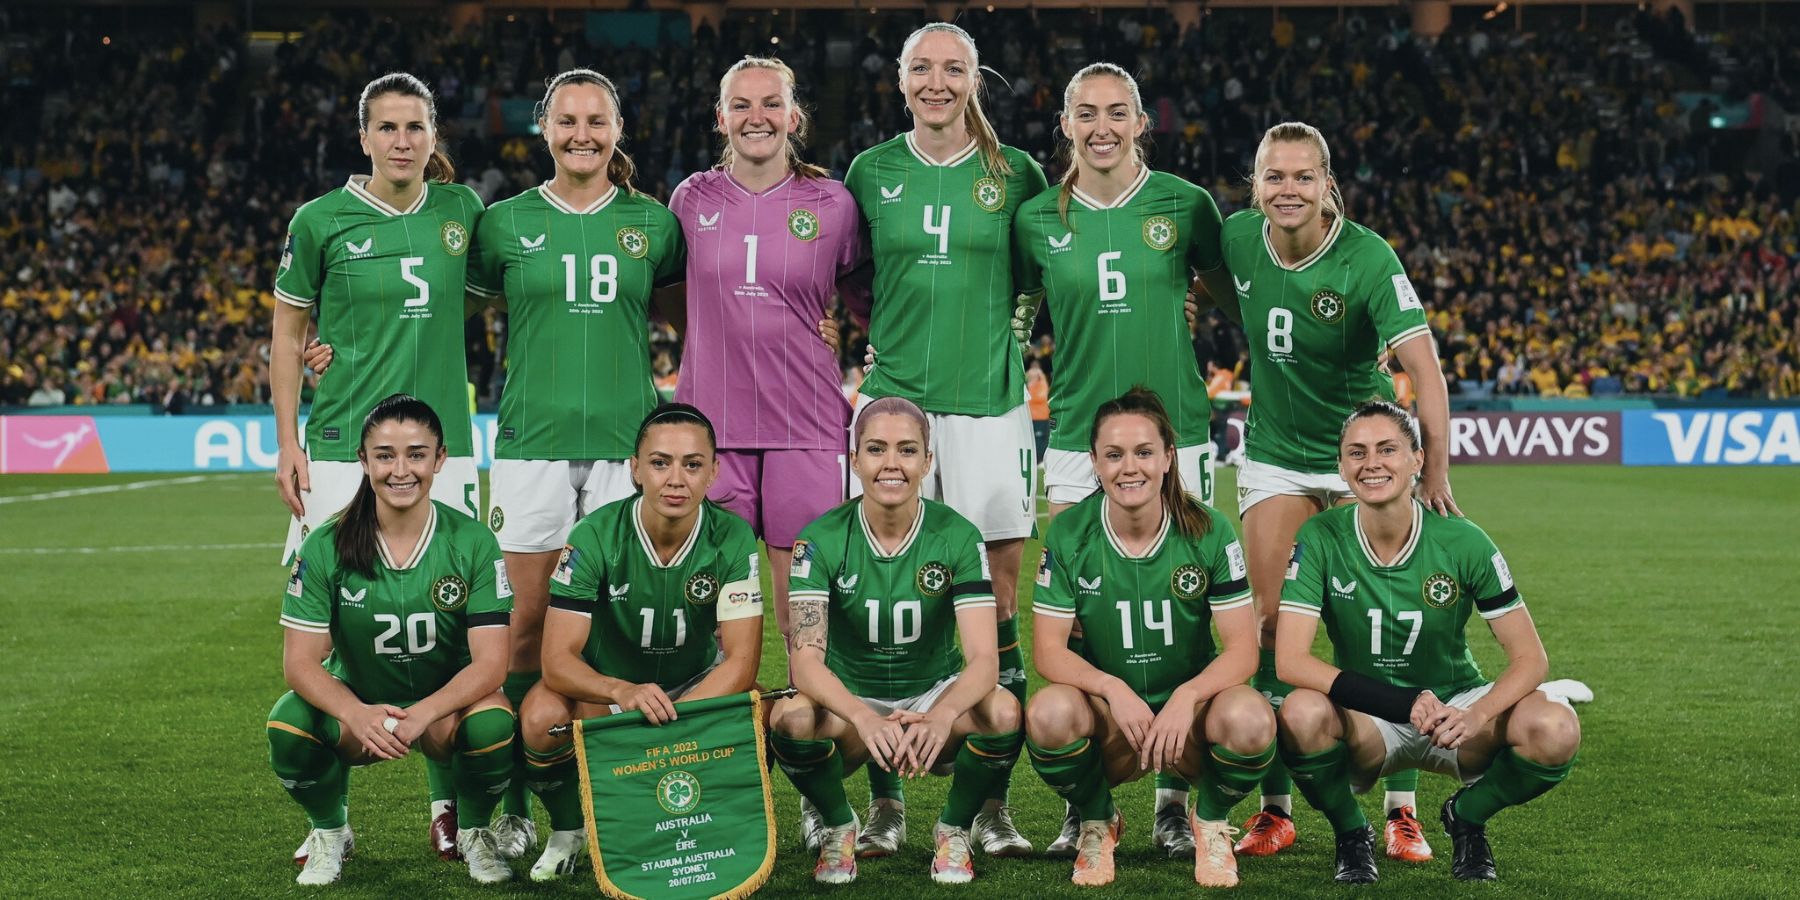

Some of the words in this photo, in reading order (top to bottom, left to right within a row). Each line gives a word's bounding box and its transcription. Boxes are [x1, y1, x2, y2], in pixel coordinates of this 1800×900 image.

[923, 205, 951, 253] 4
[562, 254, 617, 302] 18
[744, 235, 757, 283] 1
[1098, 251, 1126, 301] 6
[401, 257, 429, 307] 5
[1267, 307, 1293, 353] 8
[194, 420, 279, 468] AU
[1449, 417, 1610, 457] RWAYS
[1651, 411, 1800, 464] VISA
[1020, 448, 1031, 497] 4
[1199, 452, 1211, 501] 6
[464, 484, 477, 520] 5
[374, 612, 436, 654] 20
[640, 608, 686, 647] 11
[865, 599, 921, 644] 10
[1116, 600, 1173, 648] 14
[1367, 608, 1423, 655] 17
[613, 759, 666, 776] WOMEN'S
[670, 752, 709, 766] WORLD
[713, 748, 734, 759] CUP
[646, 746, 670, 758] FIFA
[674, 742, 698, 753] 2023
[661, 773, 695, 788] IRELAND
[656, 813, 712, 832] AUSTRALIA
[681, 829, 688, 838] V
[641, 857, 682, 871] STADIUM
[685, 848, 736, 864] AUSTRALIA
[676, 839, 697, 851] ÉIRE
[669, 872, 716, 887] 20/07/2023
[672, 863, 708, 876] SYDNEY
